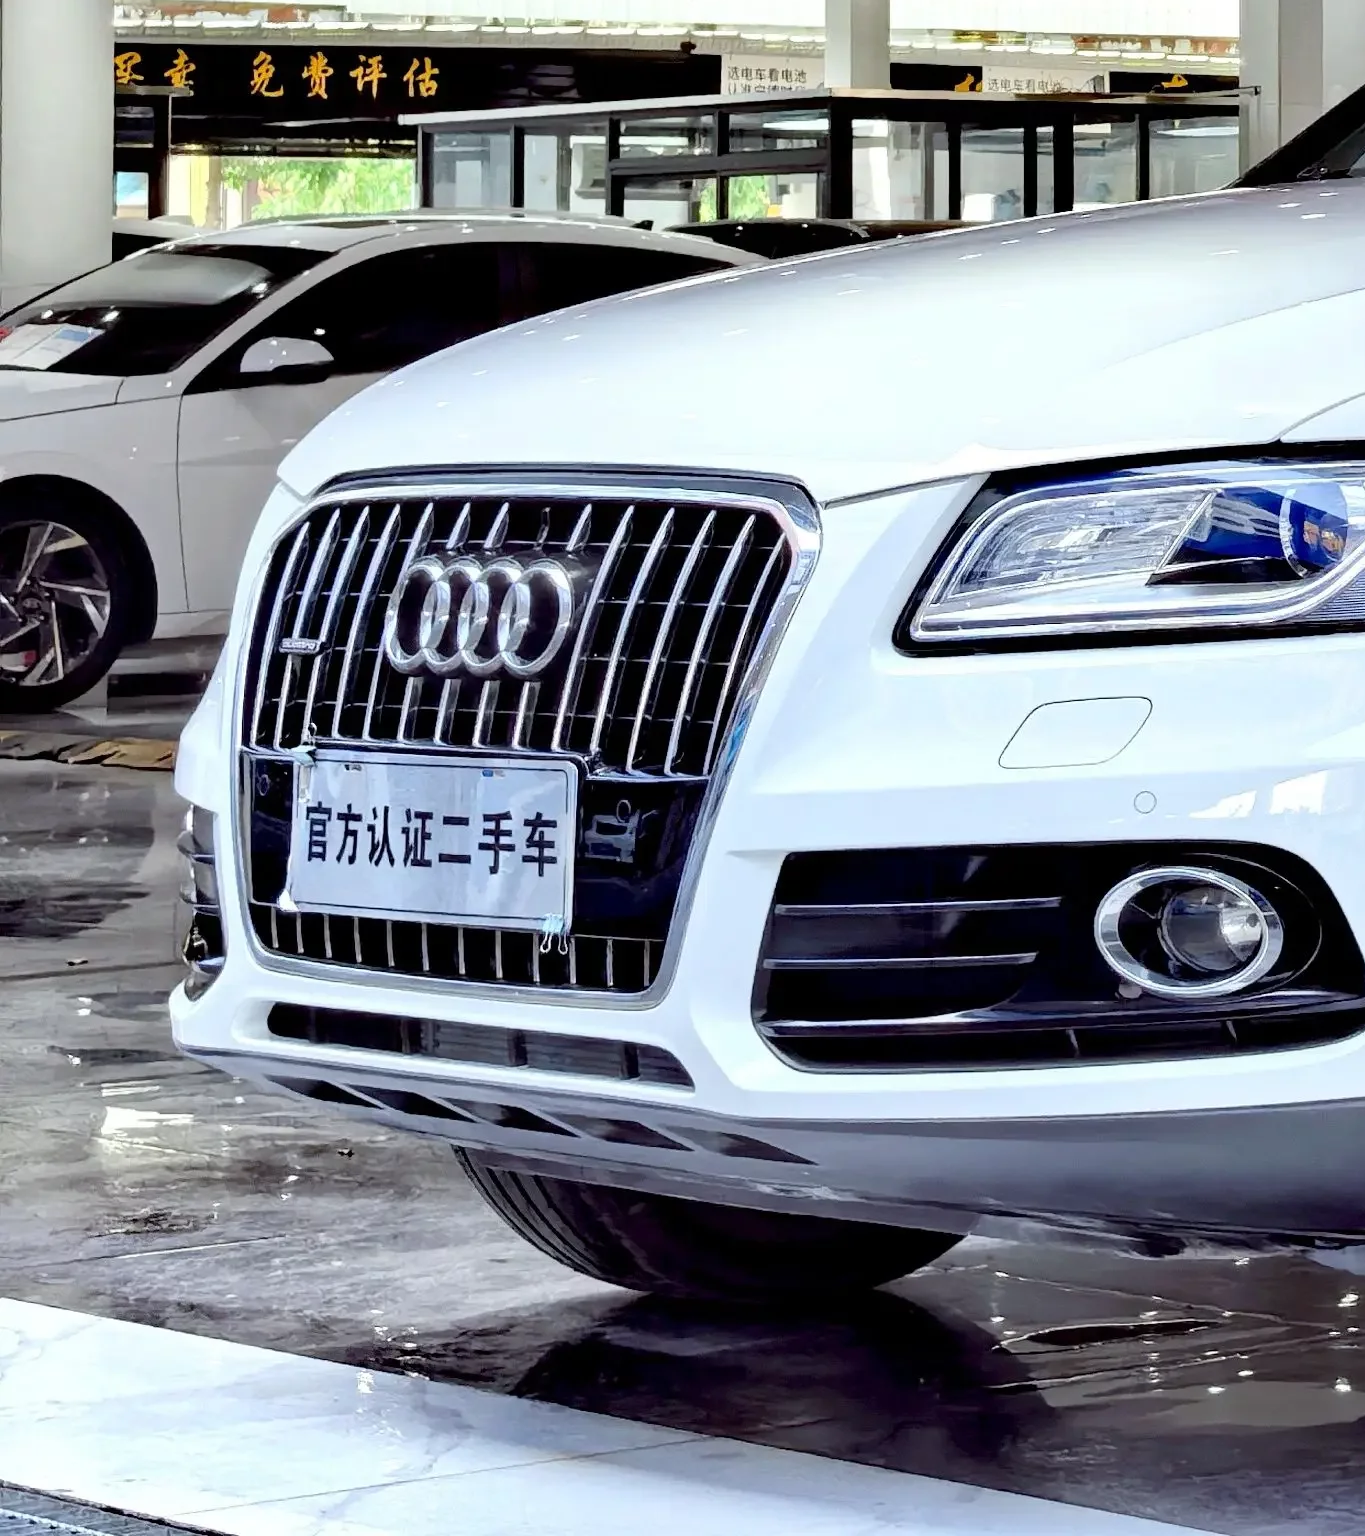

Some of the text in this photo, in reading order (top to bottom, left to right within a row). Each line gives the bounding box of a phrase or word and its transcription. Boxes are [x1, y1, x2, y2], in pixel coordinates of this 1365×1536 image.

[251, 50, 440, 100] 免费评估
[728, 66, 807, 83] 选电车看电池
[306, 802, 558, 877] 官方认证二手车
